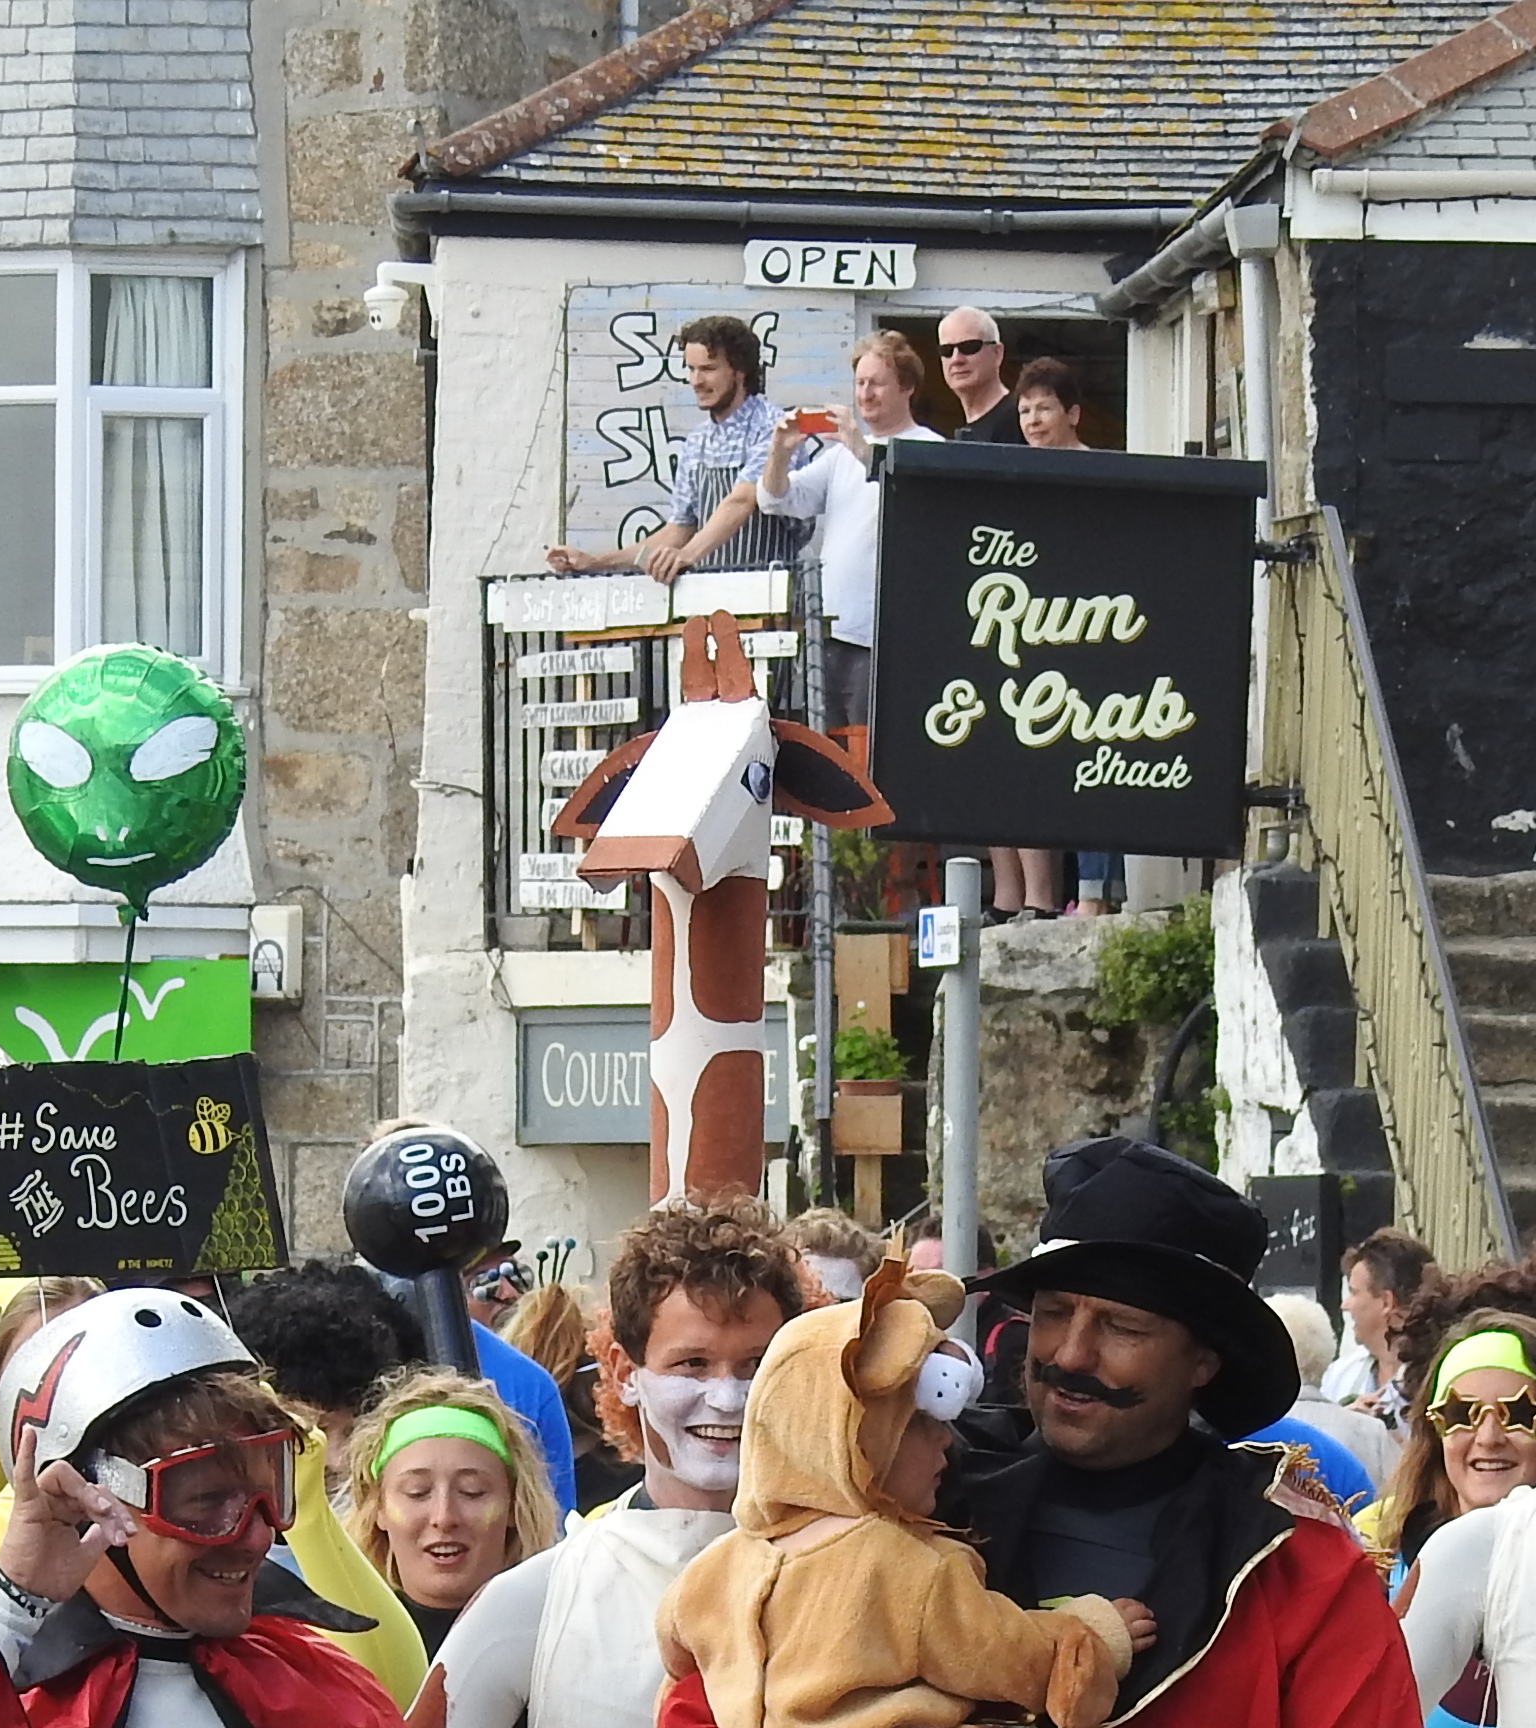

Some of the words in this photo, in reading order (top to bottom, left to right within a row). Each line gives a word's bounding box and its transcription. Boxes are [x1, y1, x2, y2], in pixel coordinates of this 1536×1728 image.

[760, 246, 898, 286] OPEN
[967, 525, 1039, 568] The
[522, 590, 555, 623] Surf
[966, 571, 1148, 668] Rum
[540, 655, 577, 676] CREAM
[579, 651, 606, 674] TEAS
[924, 678, 987, 747] &
[999, 669, 1197, 749] Crab
[550, 756, 590, 780] CAKES
[1073, 744, 1193, 793] Shack
[541, 1042, 648, 1108] COURT
[13, 1179, 63, 1228] THE
[69, 1153, 188, 1230] Bees
[398, 1143, 449, 1244] 1000
[439, 1153, 475, 1222] LBS
